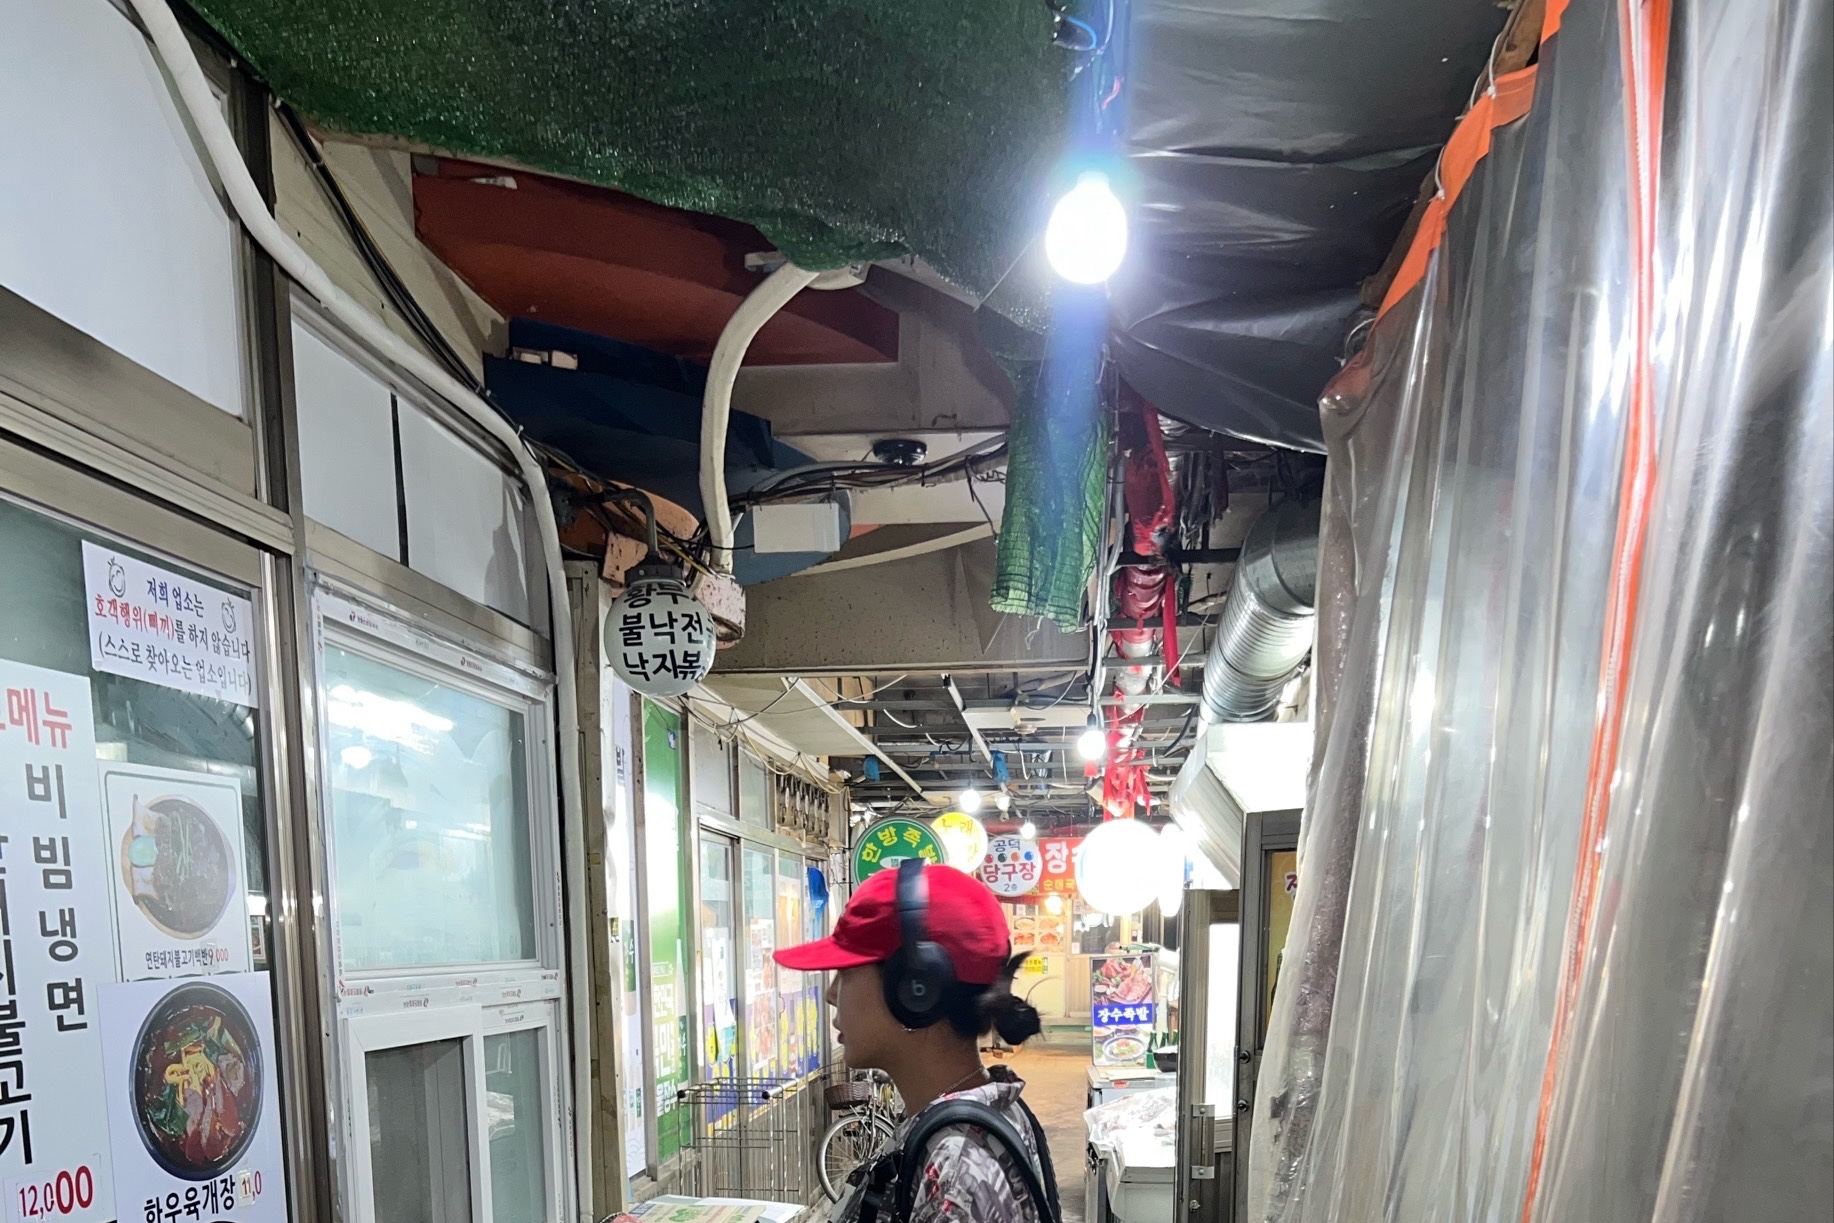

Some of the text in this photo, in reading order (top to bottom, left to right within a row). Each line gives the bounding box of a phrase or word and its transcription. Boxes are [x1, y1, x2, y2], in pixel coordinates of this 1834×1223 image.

[147, 578, 205, 618] 저희 업소는
[187, 624, 209, 651] 하지
[211, 631, 251, 664] 않습니다
[145, 644, 193, 681] 찾아오는
[622, 649, 706, 682] 낙지볶
[0, 687, 73, 750] 메뉴
[993, 839, 1021, 853] 공덕
[983, 862, 1036, 884] 당구장
[1003, 883, 1018, 893] 2층
[1097, 1006, 1149, 1023] 장수족발
[19, 1165, 93, 1220] 12,000
